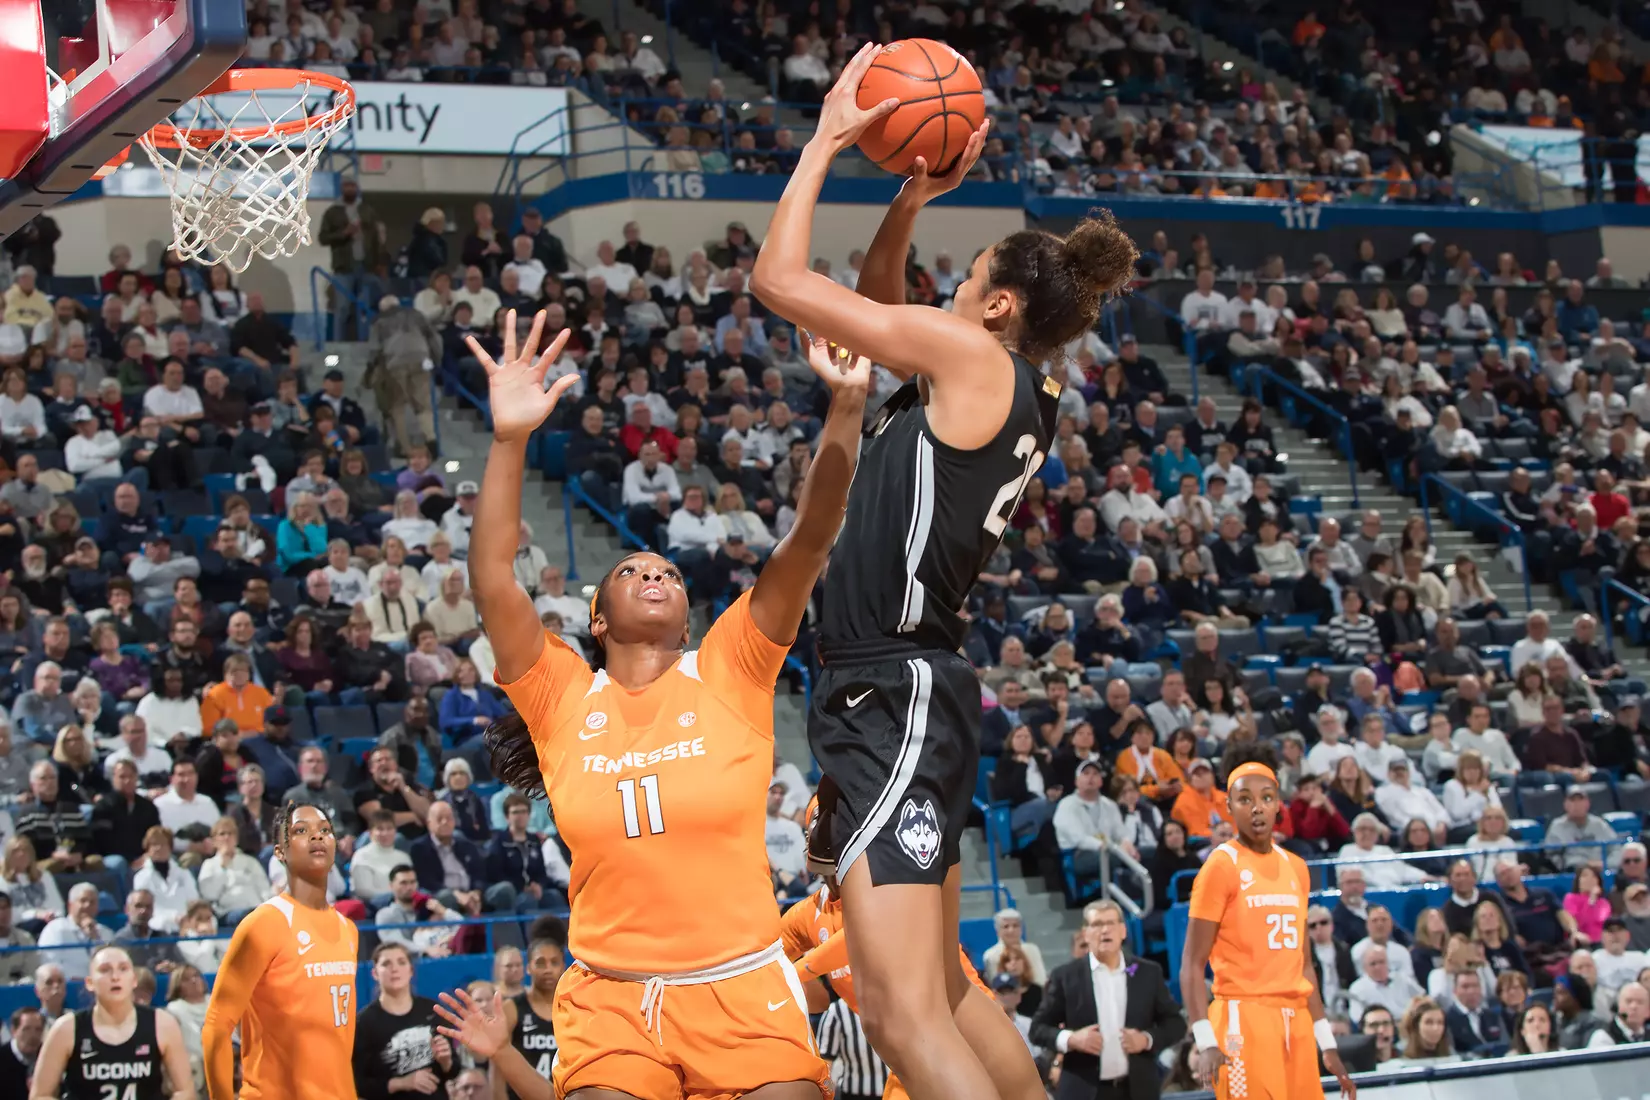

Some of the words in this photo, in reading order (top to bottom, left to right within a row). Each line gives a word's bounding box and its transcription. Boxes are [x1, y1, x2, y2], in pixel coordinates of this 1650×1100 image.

[653, 172, 705, 199] 116
[1281, 206, 1321, 229] 117
[582, 736, 706, 774] TENNESSEE
[616, 774, 665, 839] 11
[1265, 913, 1298, 950] 25
[329, 984, 351, 1028] 13
[523, 1034, 558, 1050] UCO
[83, 1061, 151, 1080] UCONN
[535, 1053, 551, 1080] 4
